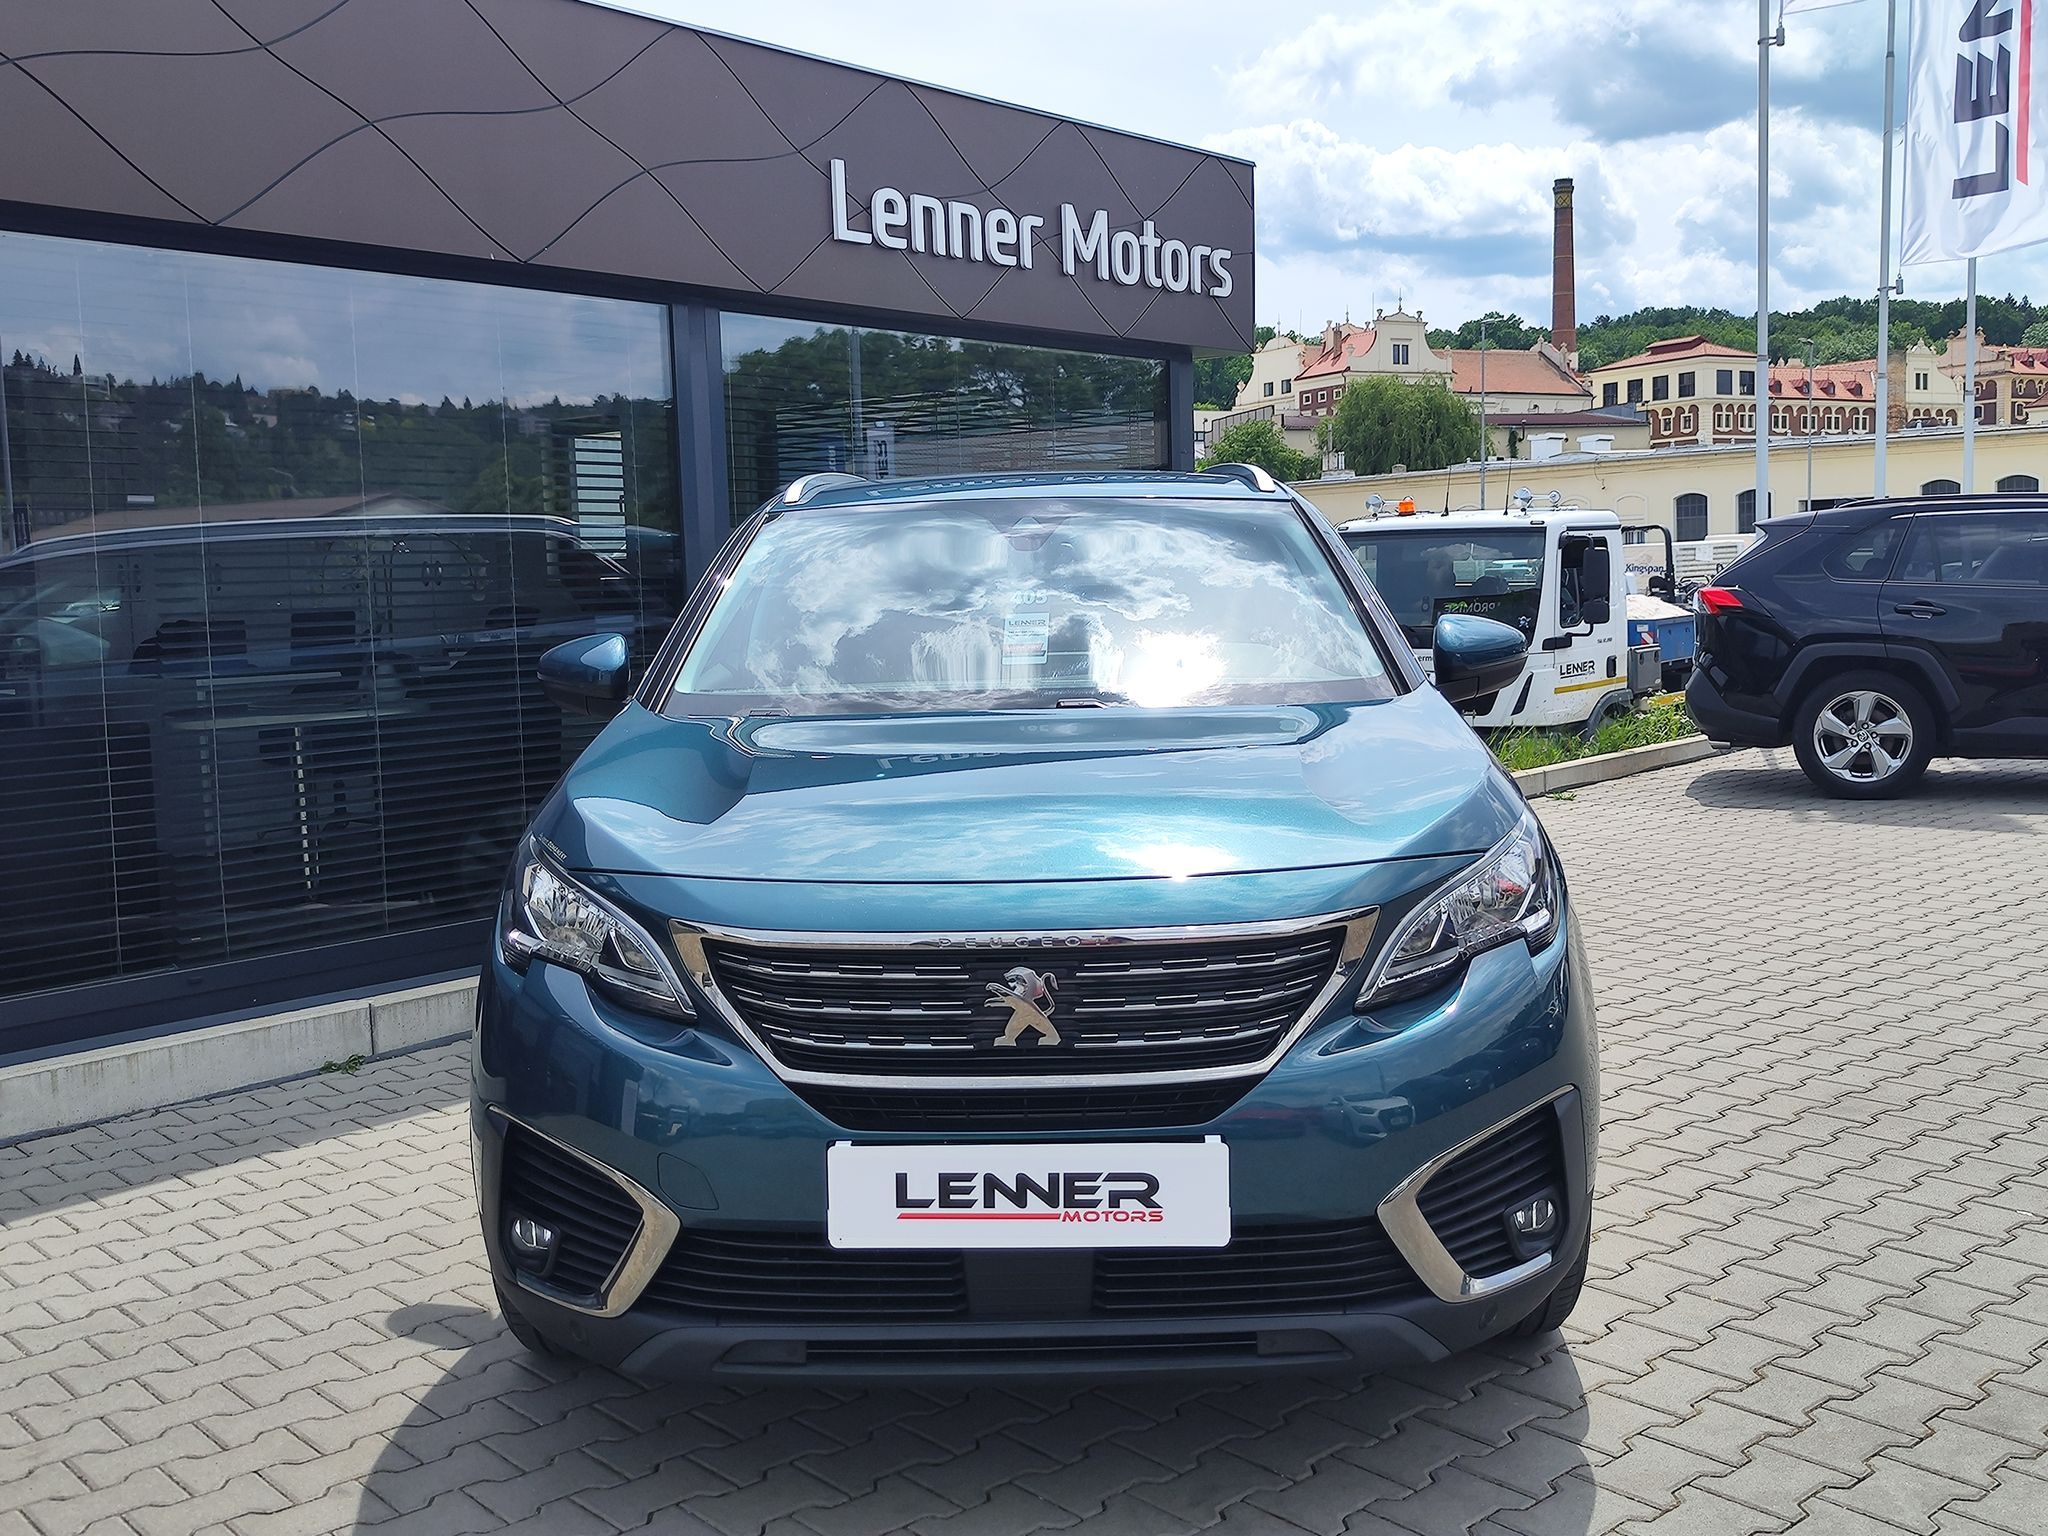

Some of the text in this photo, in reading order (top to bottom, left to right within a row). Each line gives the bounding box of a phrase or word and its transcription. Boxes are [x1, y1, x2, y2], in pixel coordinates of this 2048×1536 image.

[829, 158, 1234, 299] Lenner Motors
[1624, 563, 1664, 575] Kingspan
[1560, 660, 1595, 676] LENNER
[939, 935, 1105, 949] PEUGEOT
[895, 1171, 1163, 1209] LENNER
[1061, 1210, 1164, 1222] MOTORS
